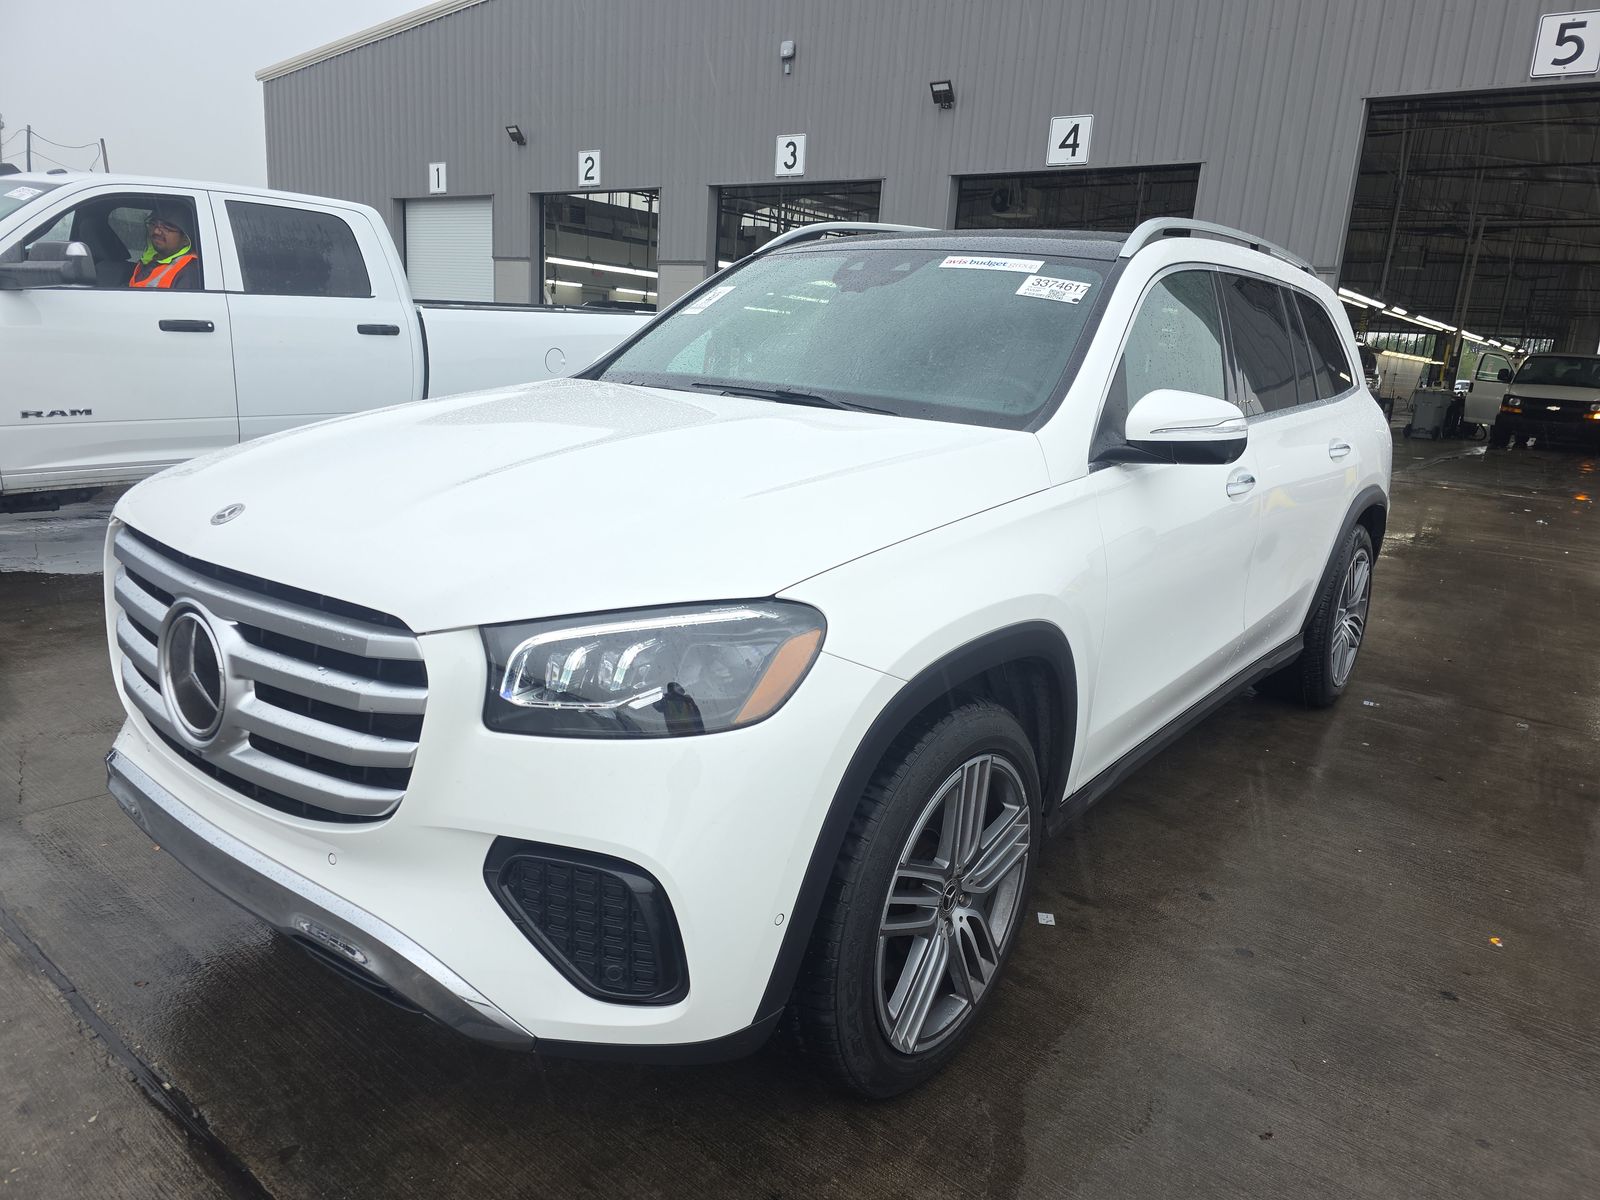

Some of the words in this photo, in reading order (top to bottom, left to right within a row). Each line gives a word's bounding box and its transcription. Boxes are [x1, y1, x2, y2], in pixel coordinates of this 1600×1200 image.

[1551, 20, 1587, 66] 5
[1058, 123, 1080, 157] 4
[783, 141, 798, 170] 3
[435, 167, 441, 188] 1
[584, 156, 595, 181] 2
[969, 259, 1008, 268] budget
[1032, 278, 1089, 294] 3374617
[21, 408, 92, 418] RAM
